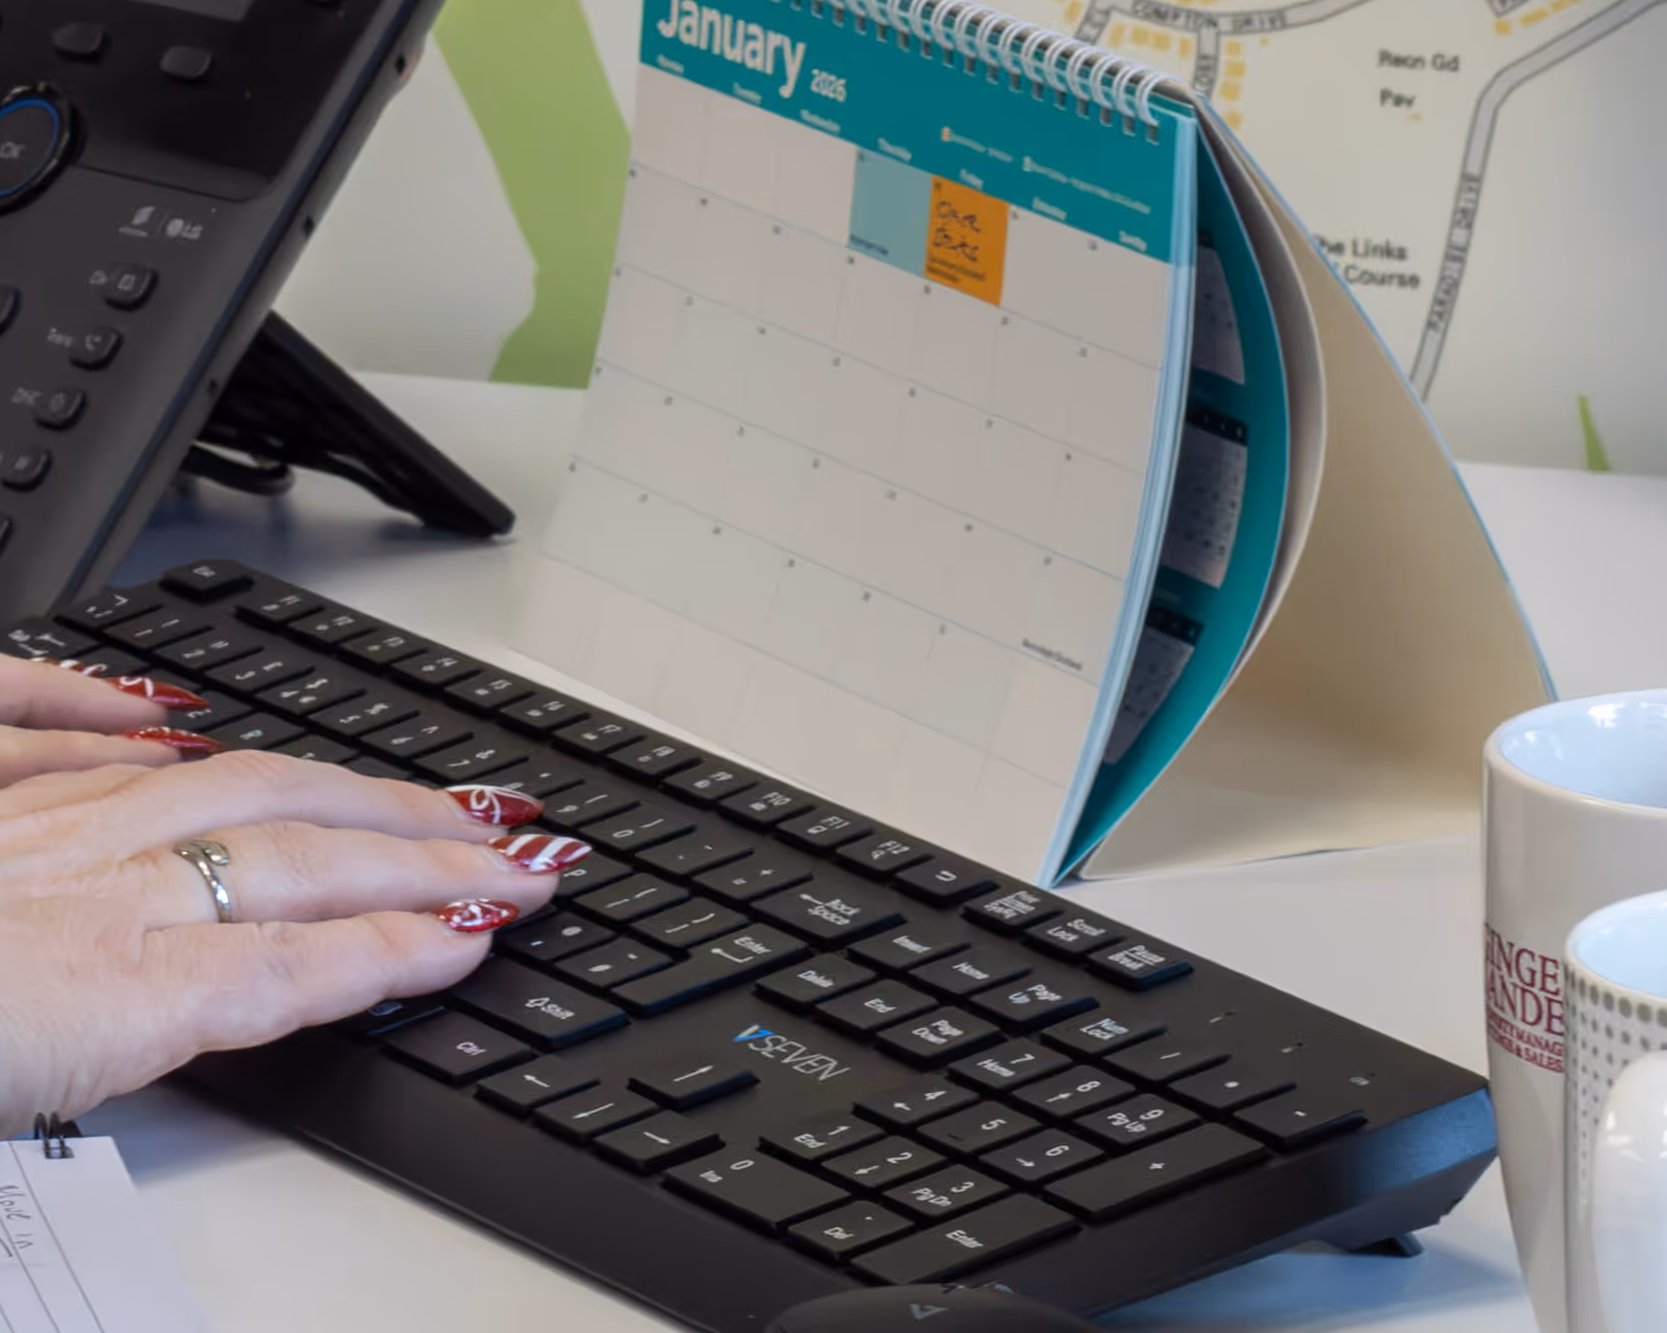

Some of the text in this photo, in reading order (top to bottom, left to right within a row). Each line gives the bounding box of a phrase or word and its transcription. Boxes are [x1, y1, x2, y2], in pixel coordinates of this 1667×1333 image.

[1378, 49, 1460, 72] Recn Gd
[810, 68, 848, 102] 2026
[1380, 89, 1416, 109] Pav
[1352, 240, 1408, 261] Links
[1345, 266, 1421, 289] Course
[828, 899, 860, 916] Back
[734, 936, 772, 956] Enter
[541, 1002, 575, 1020] Shift
[864, 997, 895, 1014] End
[456, 1041, 486, 1057] Ctrl
[1011, 1054, 1035, 1064] 7
[977, 1058, 1017, 1078] Home
[1077, 1080, 1101, 1092] 8
[925, 1090, 946, 1101] 4
[1141, 1108, 1165, 1121] 9
[981, 1119, 1006, 1130] 5
[794, 1131, 827, 1148] End
[886, 1151, 913, 1164] 2
[1044, 1145, 1069, 1157] 6
[730, 1159, 754, 1171] 0
[950, 1181, 974, 1193] 3
[823, 1226, 853, 1241] Del
[946, 1229, 984, 1249] Enter
